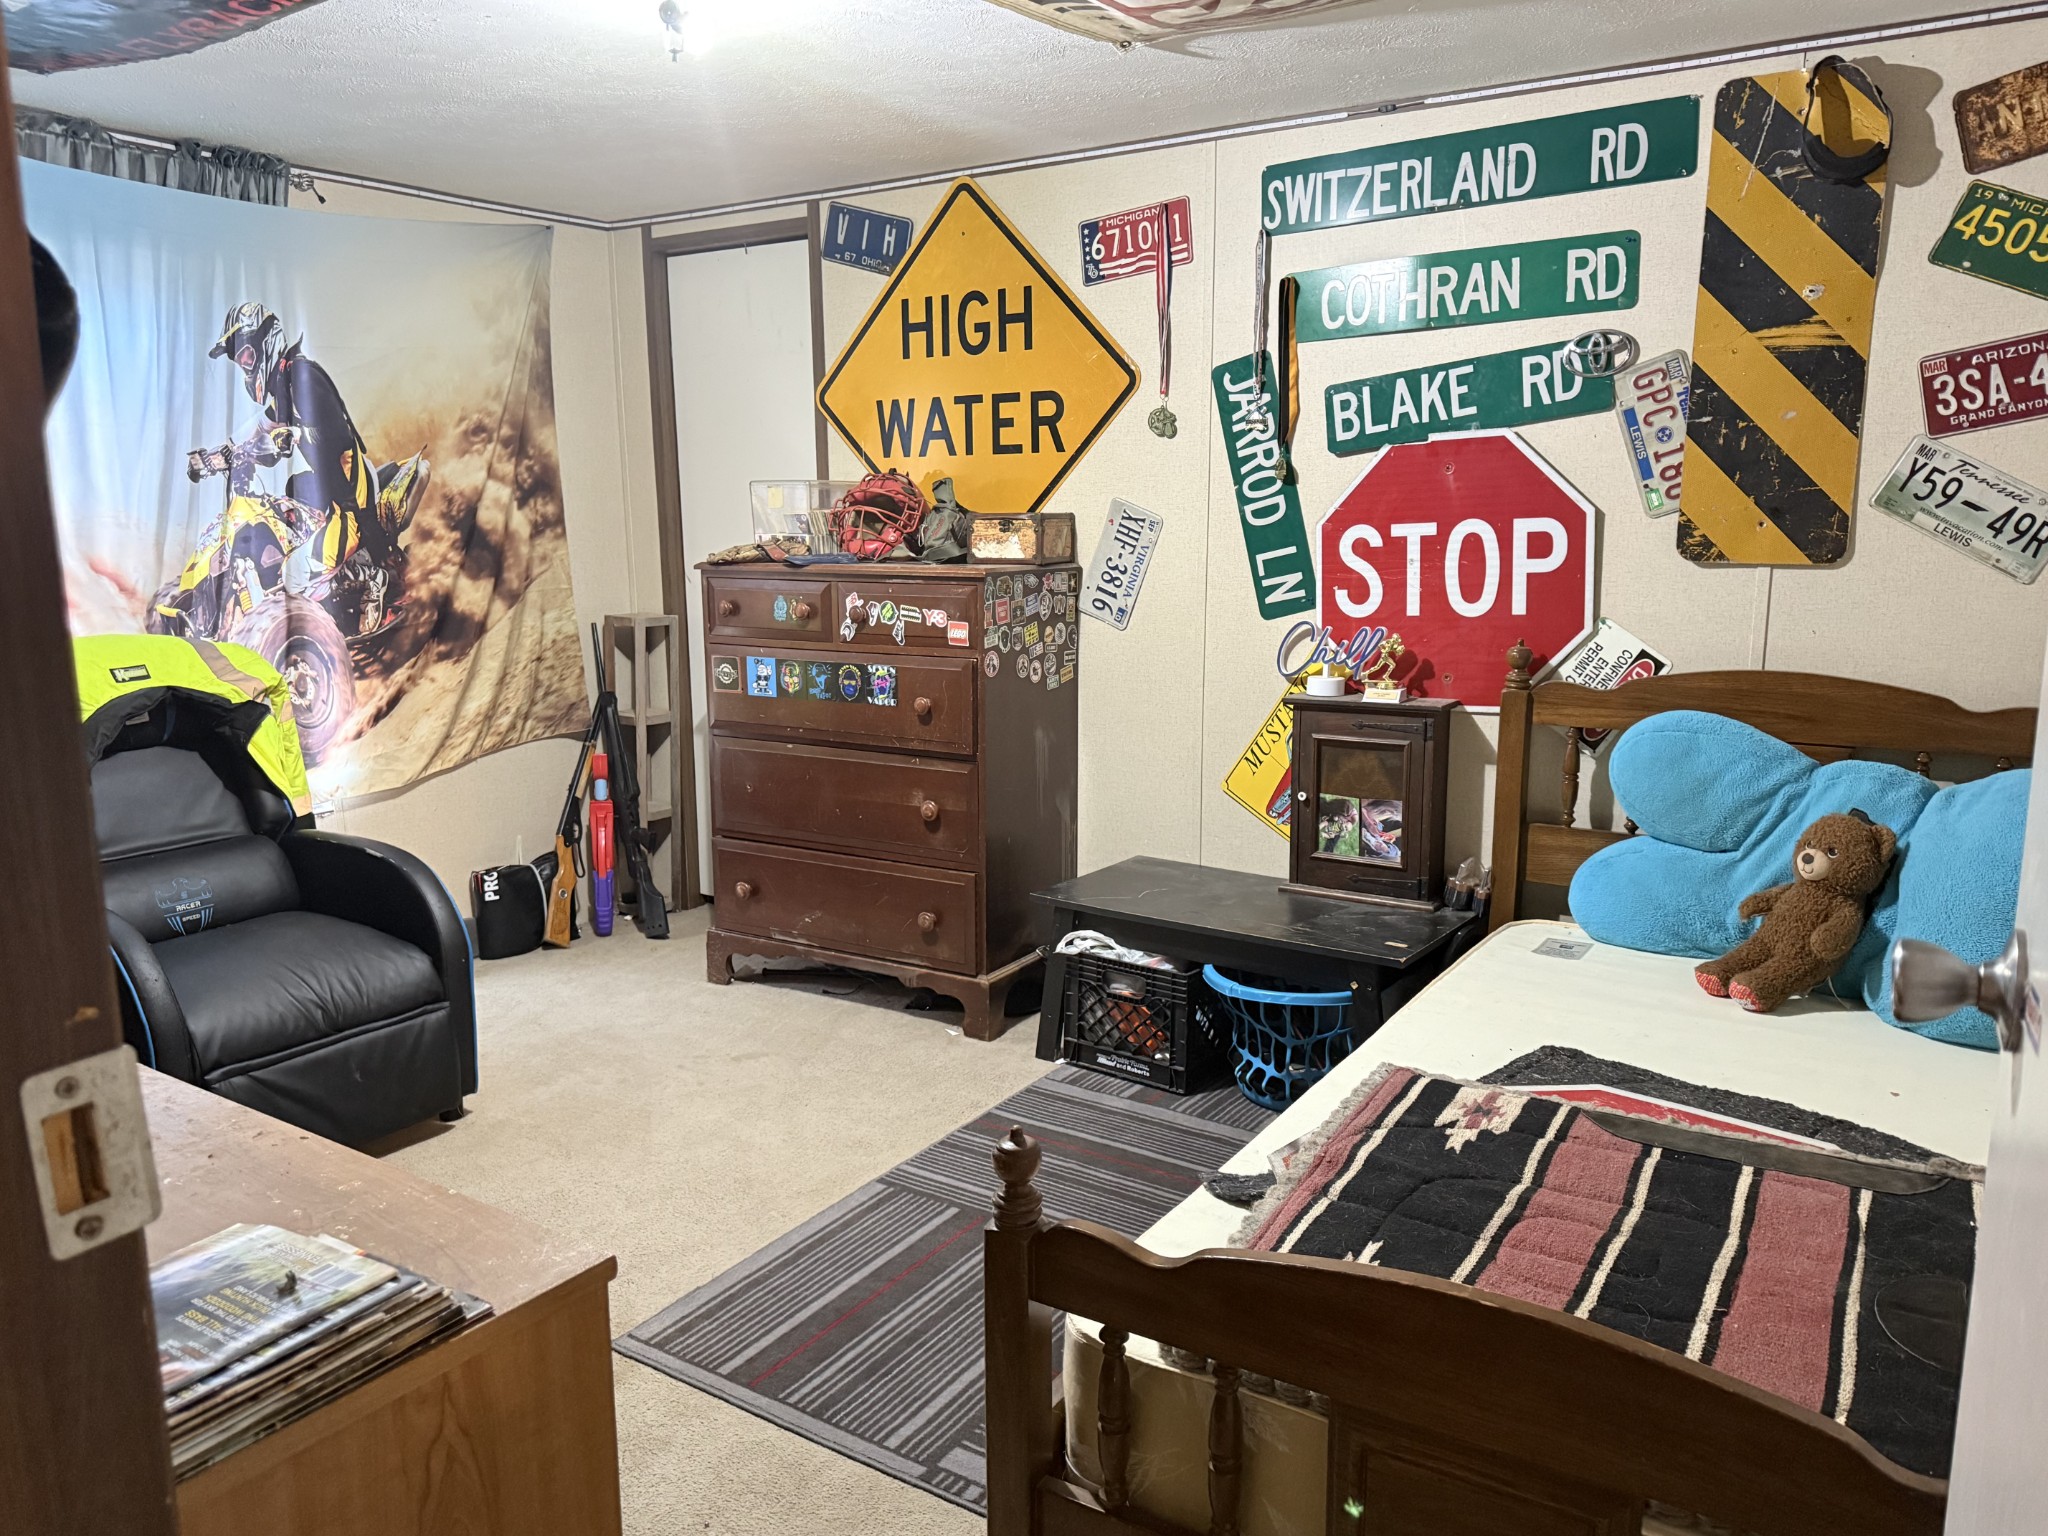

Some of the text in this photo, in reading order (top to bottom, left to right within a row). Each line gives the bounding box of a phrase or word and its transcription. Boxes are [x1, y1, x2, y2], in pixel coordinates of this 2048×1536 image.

[1263, 121, 1650, 230] SWITZERLAND RD
[1975, 188, 1994, 200] 19
[1106, 207, 1160, 227] MICHIGAN
[1091, 213, 1183, 260] 67101
[844, 251, 882, 269] 67 OHIO
[1321, 256, 1521, 330] COTHRAN
[1566, 245, 1627, 303] RD
[901, 285, 1034, 360] HIGH
[1667, 358, 1683, 379] MAR
[1923, 359, 1947, 375] MAR
[1972, 340, 2048, 365] ARIZON
[1333, 349, 1582, 441] BLAKE RD
[1633, 367, 1679, 427] GPC
[1932, 353, 2048, 416] 3SA-4
[876, 390, 1066, 459] WATER
[1950, 408, 1995, 425] GRAND
[1630, 425, 1647, 459] LEWIS
[1916, 443, 1937, 461] MAR
[1223, 371, 1305, 605] JARROD LN
[1948, 459, 2030, 503] Tennessee
[1148, 519, 1156, 532] SEP
[1933, 523, 1972, 547] LEWIS
[1091, 508, 1147, 616] XHF-3816
[1123, 545, 1150, 598] VIRGINIA
[1334, 517, 1569, 618] STOP
[922, 609, 948, 628] Y-3
[950, 630, 966, 639] LEGO
[1277, 621, 1388, 680] Chill
[1573, 642, 1603, 678] PERMIT
[1596, 650, 1633, 690] CONFINE
[175, 901, 201, 911] RACER
